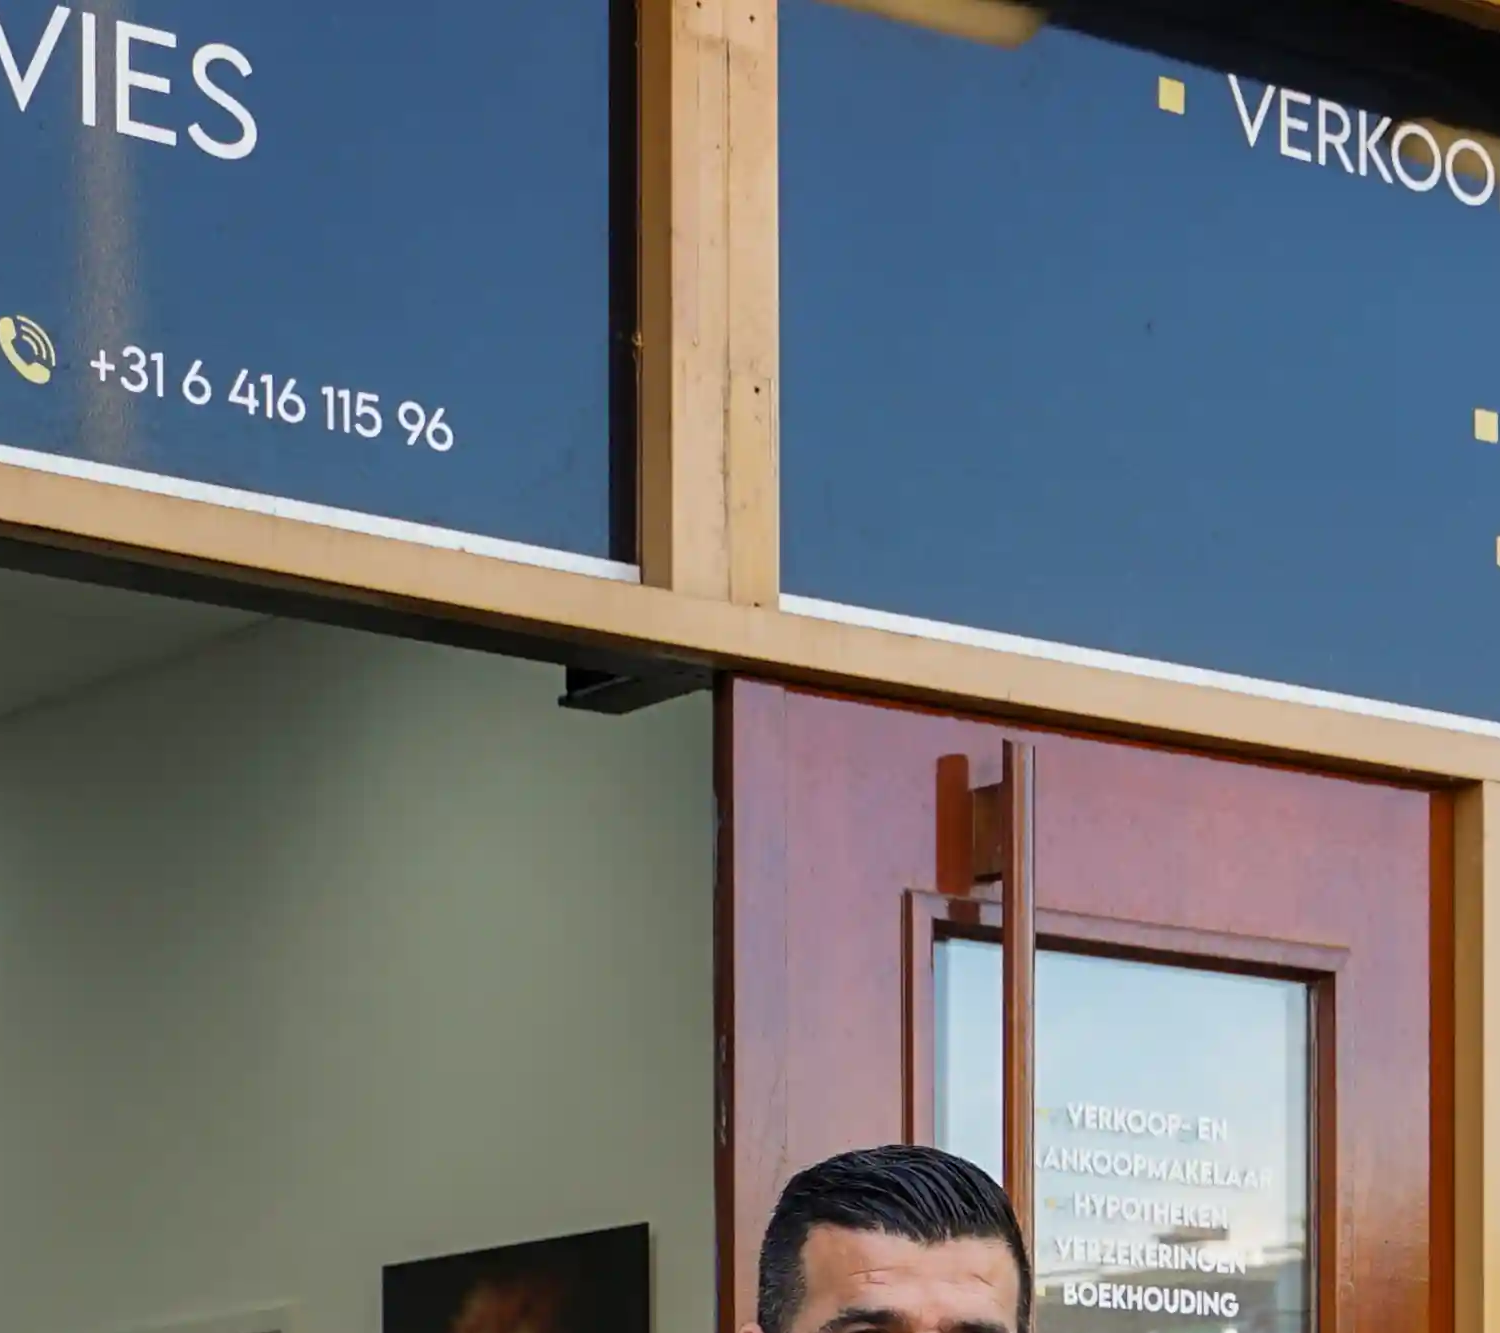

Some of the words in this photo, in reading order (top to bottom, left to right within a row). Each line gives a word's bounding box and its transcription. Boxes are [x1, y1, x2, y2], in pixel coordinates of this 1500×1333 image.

[90, 346, 164, 398] +31
[183, 356, 212, 405] 6
[228, 369, 306, 423] 416
[322, 384, 383, 438] 115
[397, 400, 455, 453] 96
[1065, 1102, 1192, 1137] VERKOOP-
[1198, 1117, 1228, 1142] EN
[1072, 1191, 1230, 1230] HYPOTHEKEN
[1055, 1235, 1247, 1275] VERZEKERINGEN
[1062, 1281, 1240, 1318] BOEKHOUDING
